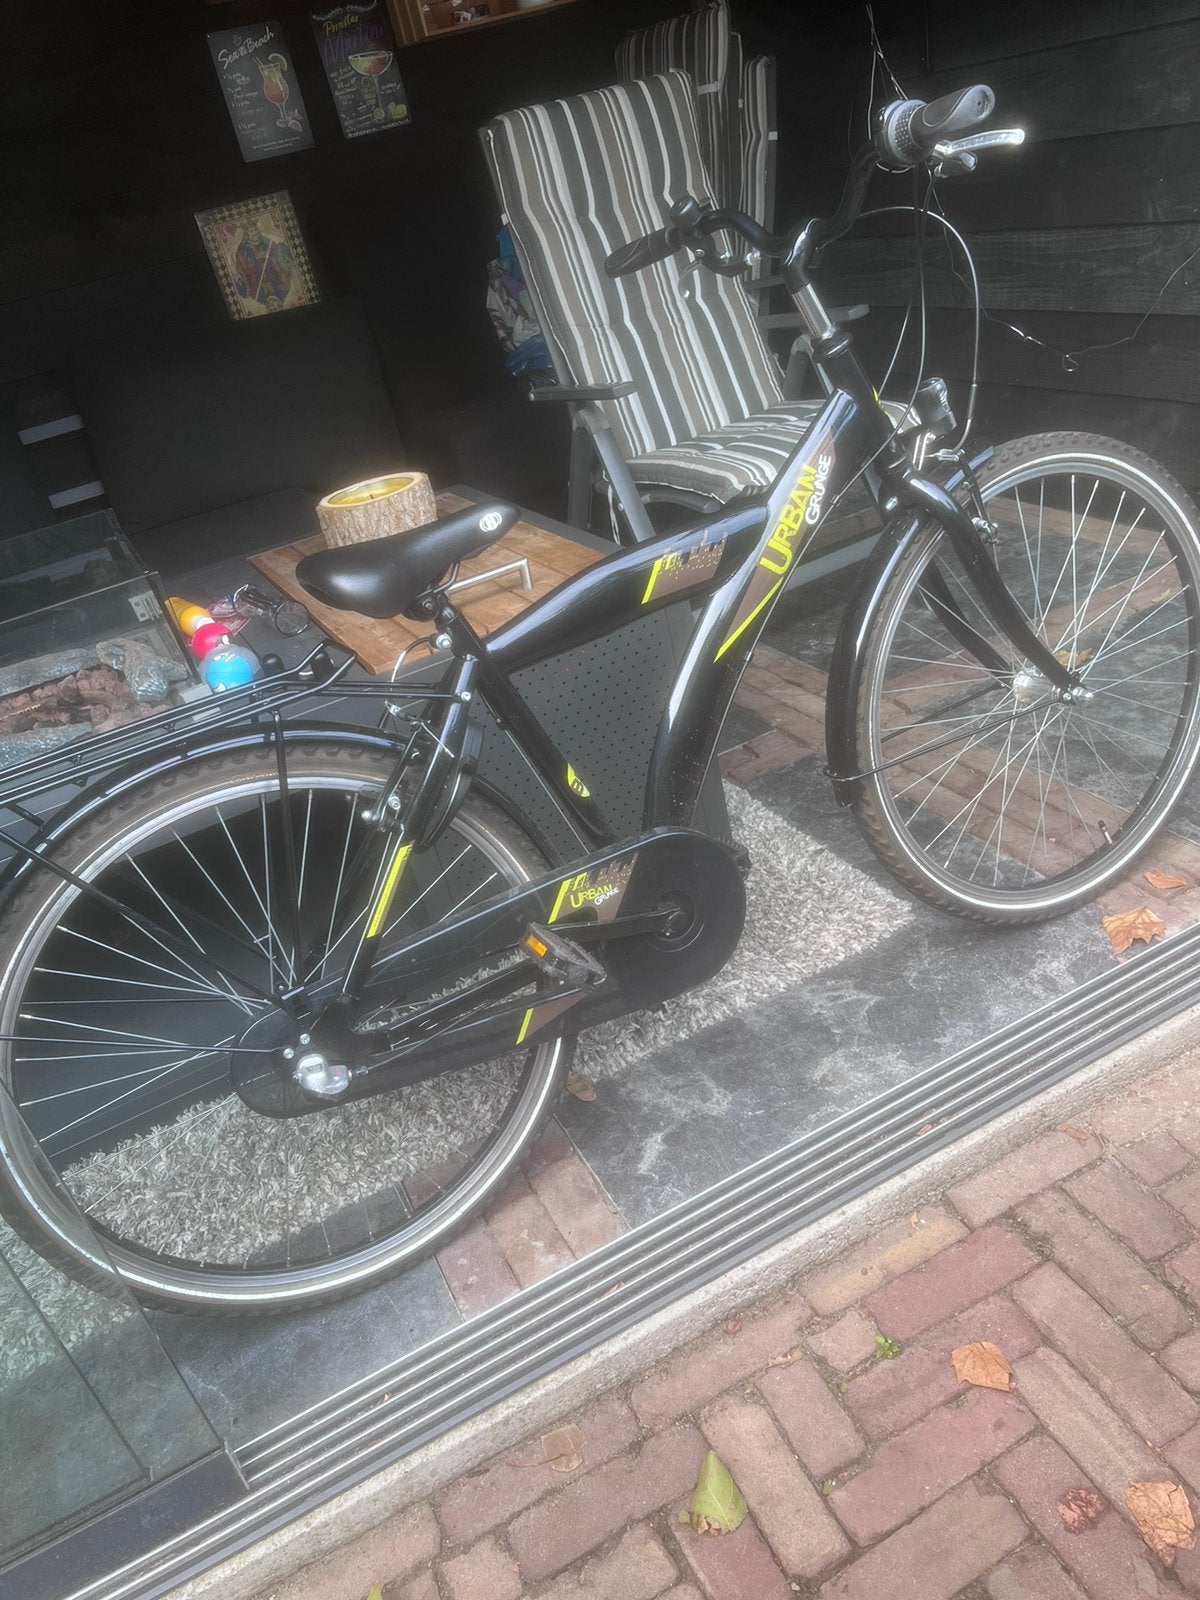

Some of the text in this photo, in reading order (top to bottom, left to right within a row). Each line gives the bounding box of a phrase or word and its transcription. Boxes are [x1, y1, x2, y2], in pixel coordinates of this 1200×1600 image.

[759, 465, 818, 576] URBAN
[805, 454, 832, 526] GRUNGE
[570, 884, 612, 908] URBAN
